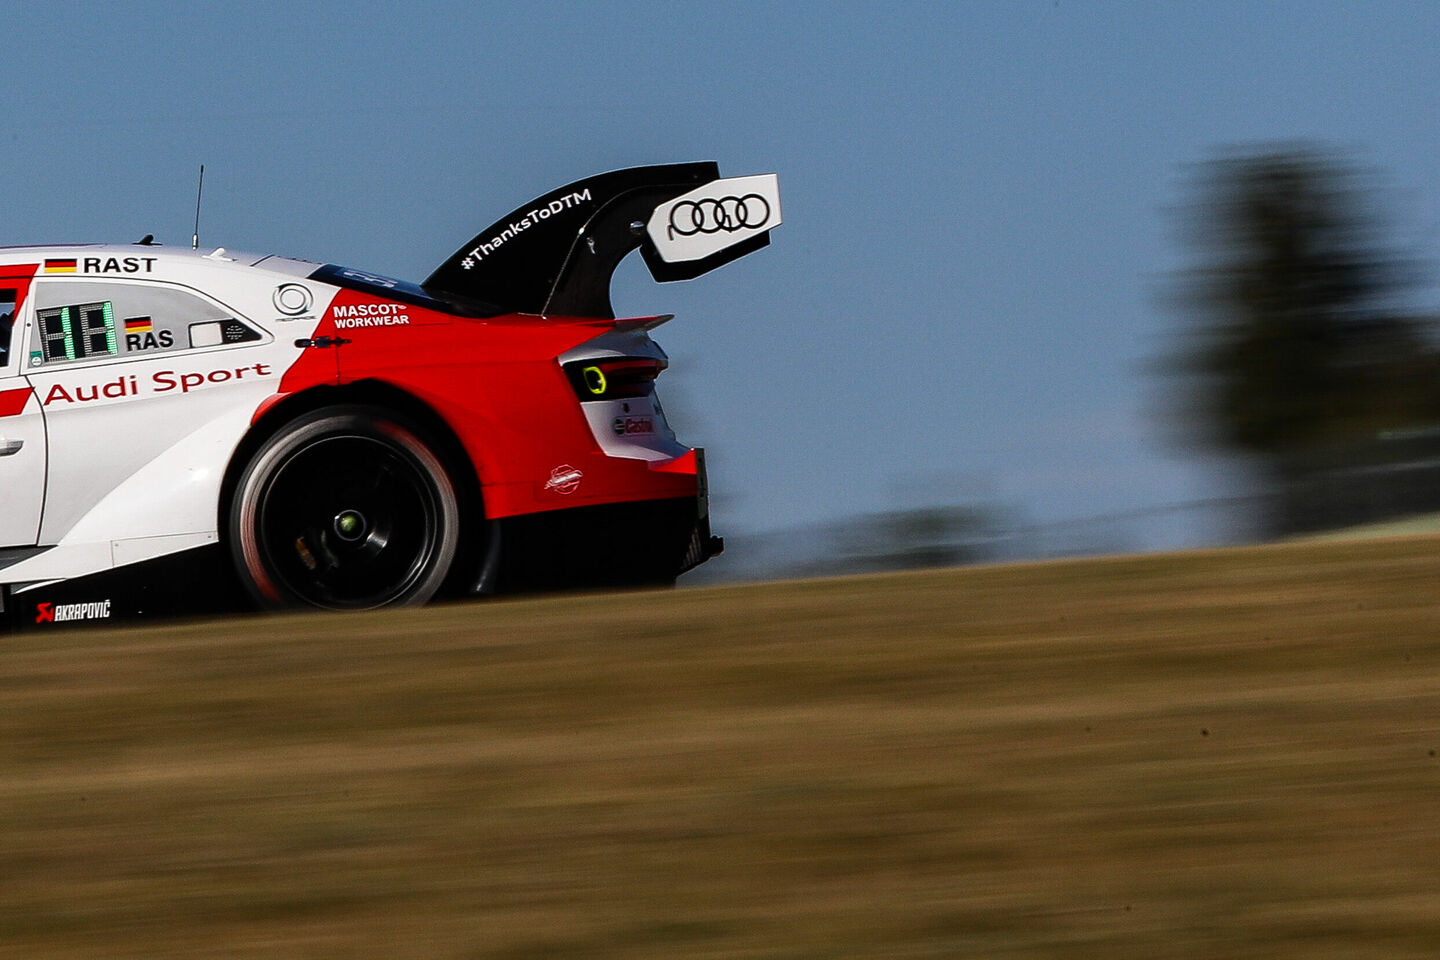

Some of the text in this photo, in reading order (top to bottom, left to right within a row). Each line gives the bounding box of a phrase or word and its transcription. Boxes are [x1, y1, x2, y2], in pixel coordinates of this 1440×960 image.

[461, 188, 592, 270] #ThanksToDTM
[83, 257, 159, 274] RAST
[335, 315, 410, 329] WORKWEAR
[125, 329, 175, 352] RAS
[43, 363, 272, 406] Audi Sport
